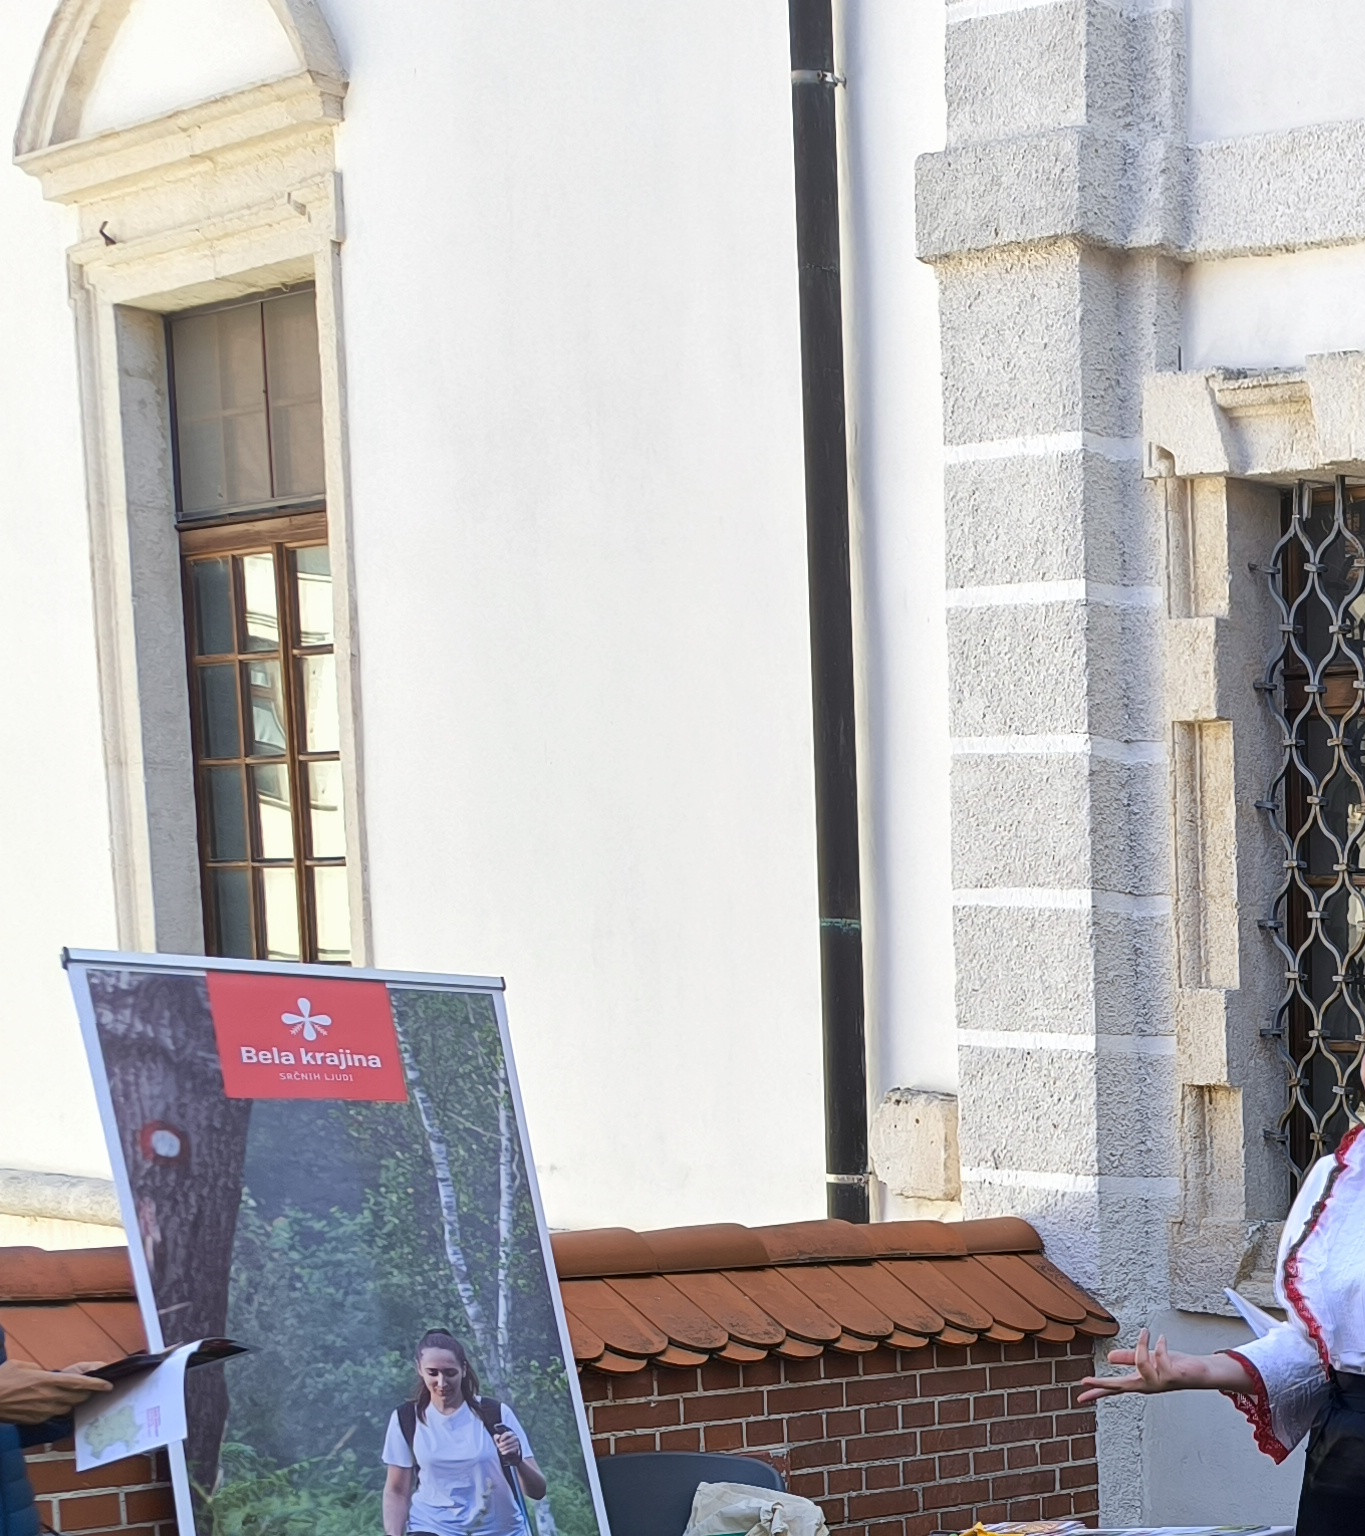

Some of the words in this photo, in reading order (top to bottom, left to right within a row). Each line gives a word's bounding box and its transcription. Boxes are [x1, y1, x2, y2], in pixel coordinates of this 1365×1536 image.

[240, 1046, 295, 1065] Bela
[299, 1047, 382, 1069] krajina
[279, 1071, 321, 1081] SRČNIH
[324, 1073, 353, 1082] LJUDI
